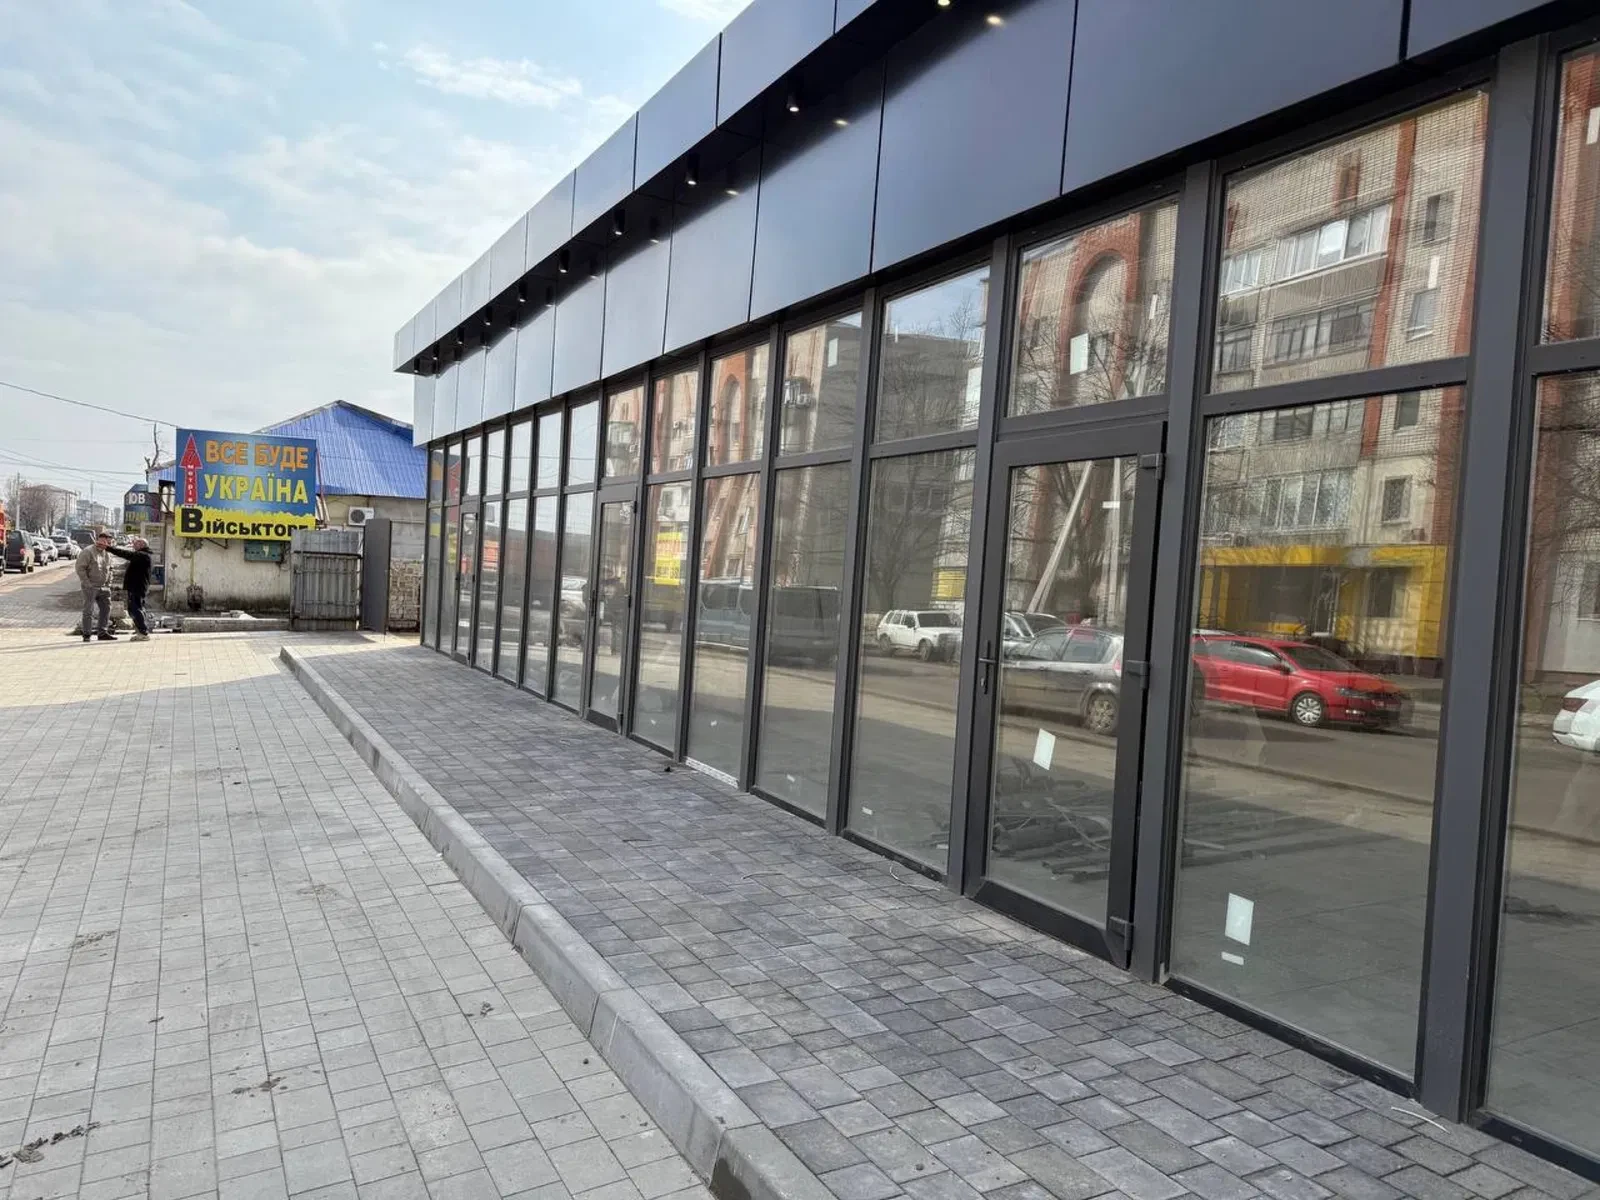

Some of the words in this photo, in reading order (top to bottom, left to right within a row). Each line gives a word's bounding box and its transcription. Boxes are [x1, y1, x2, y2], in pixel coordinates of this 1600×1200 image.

[205, 440, 249, 465] ВСЕ
[255, 443, 309, 472] БУДЕ
[203, 472, 309, 504] УКРАЇНА
